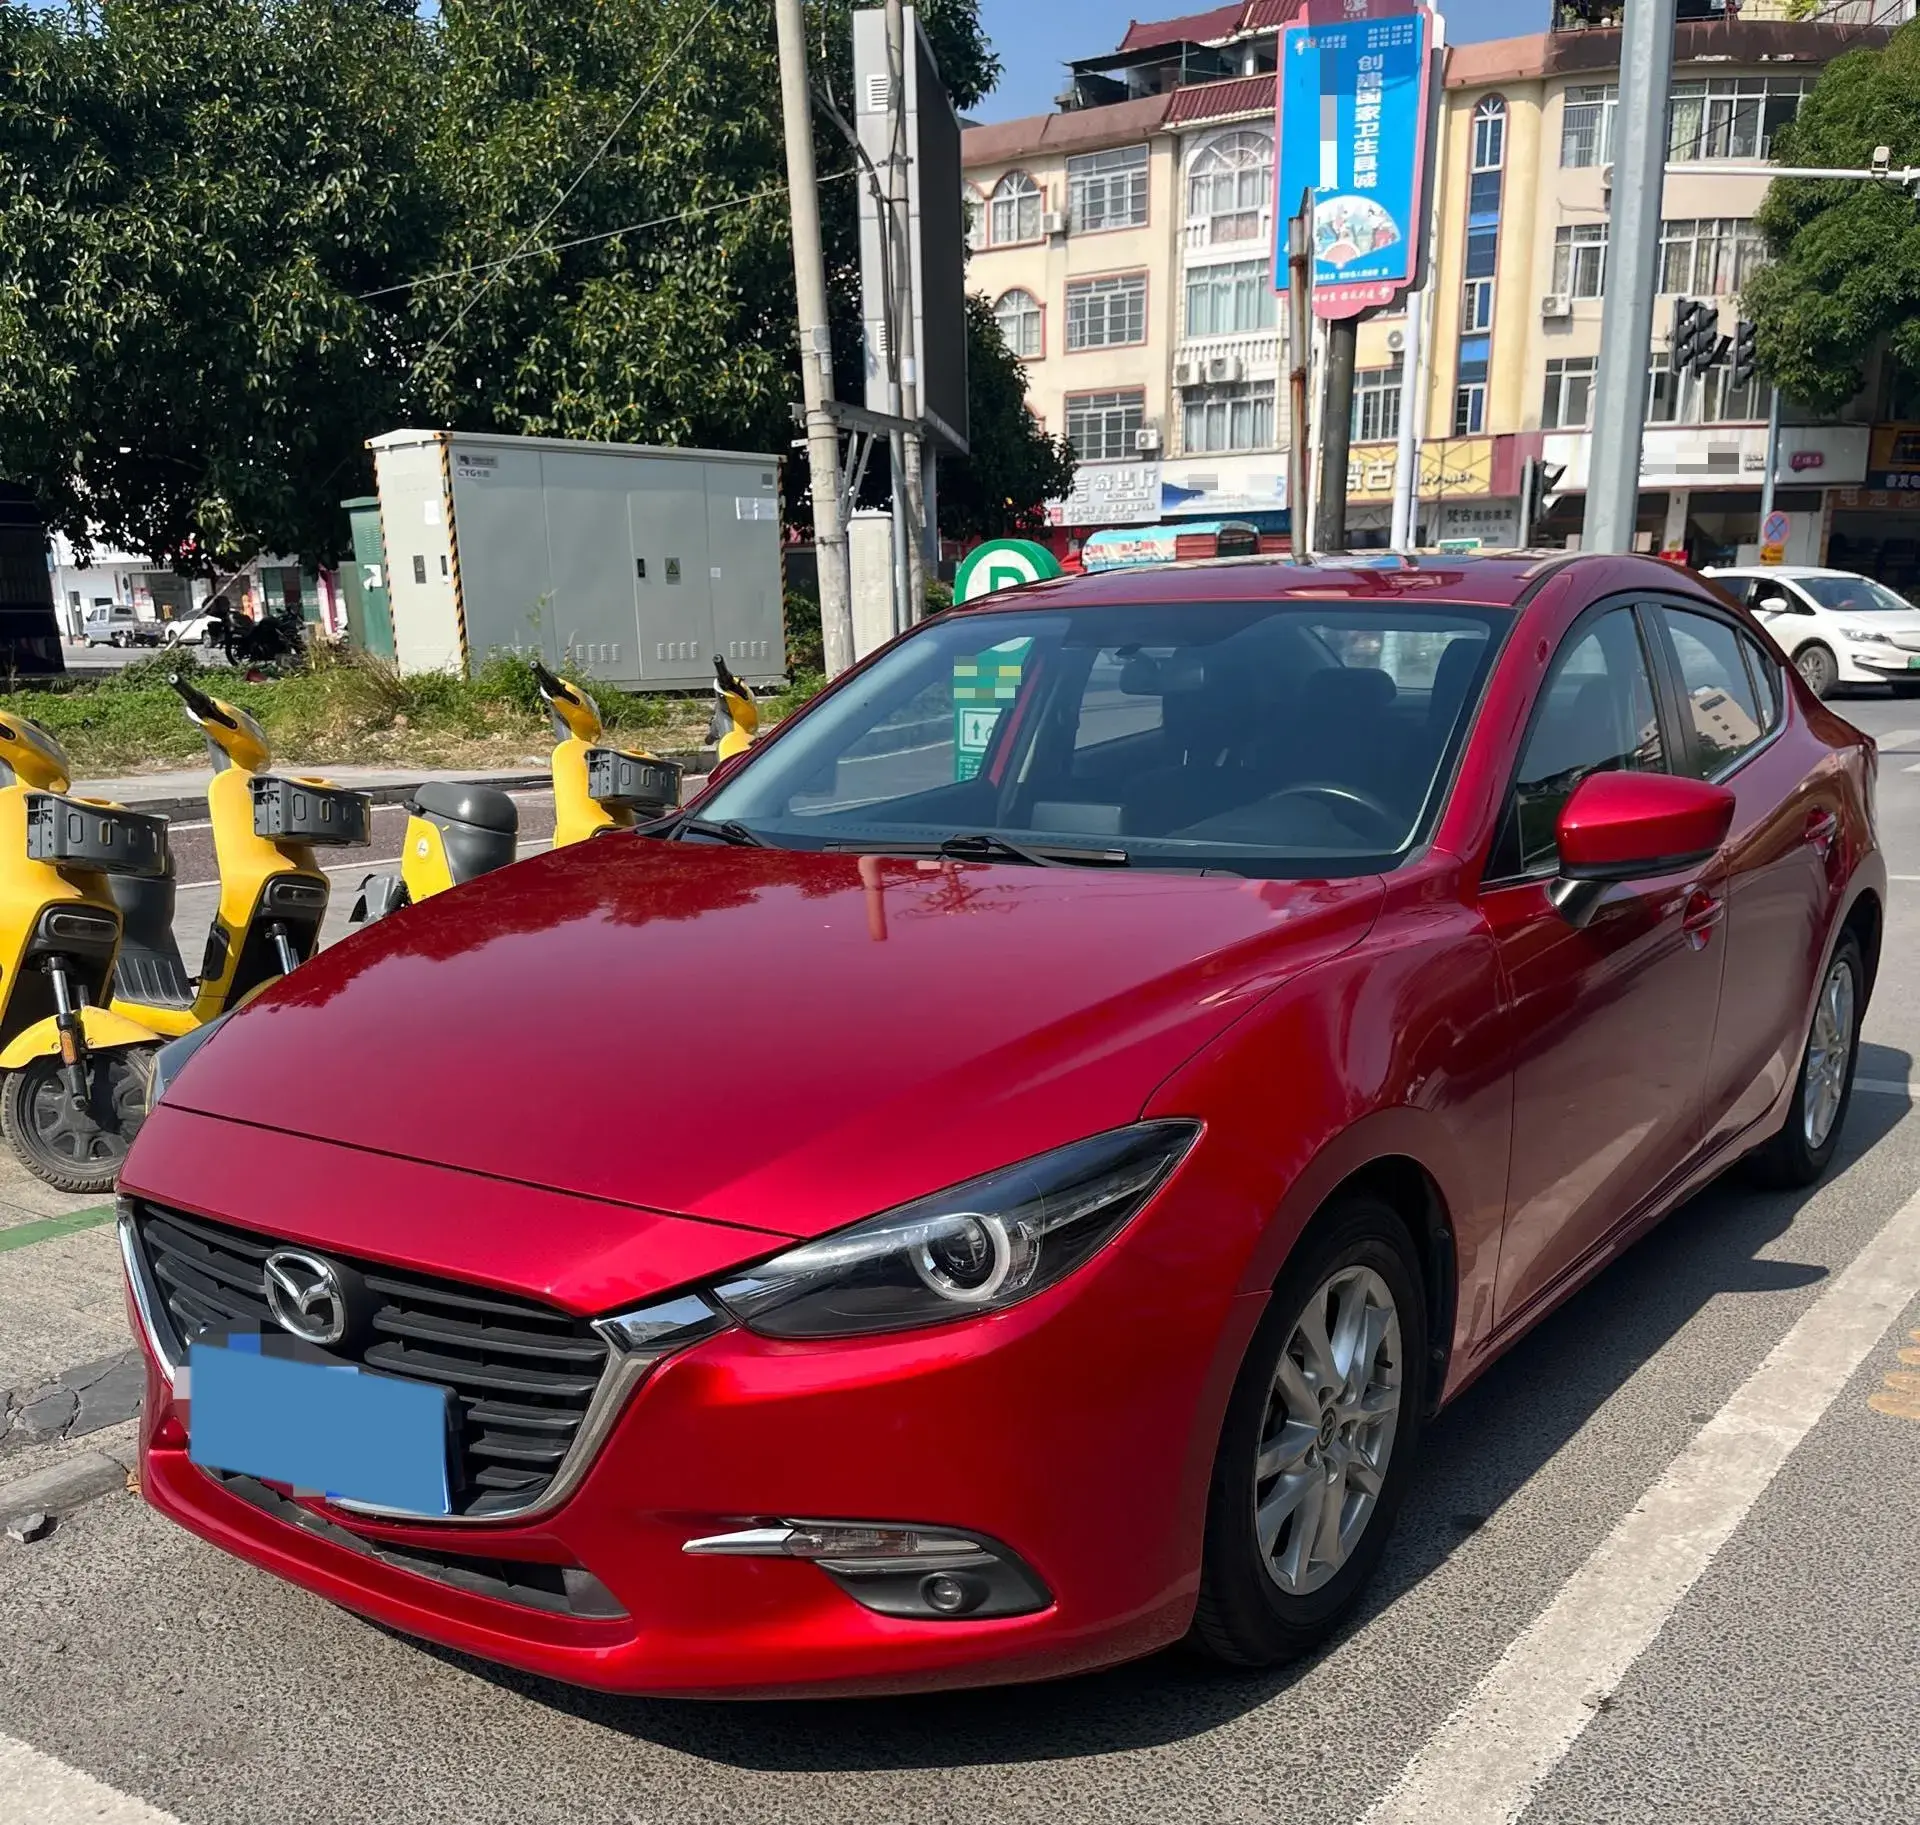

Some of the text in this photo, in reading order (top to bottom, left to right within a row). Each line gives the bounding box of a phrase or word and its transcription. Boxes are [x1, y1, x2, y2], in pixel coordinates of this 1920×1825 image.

[1353, 54, 1384, 189] 创建国家卫生县城
